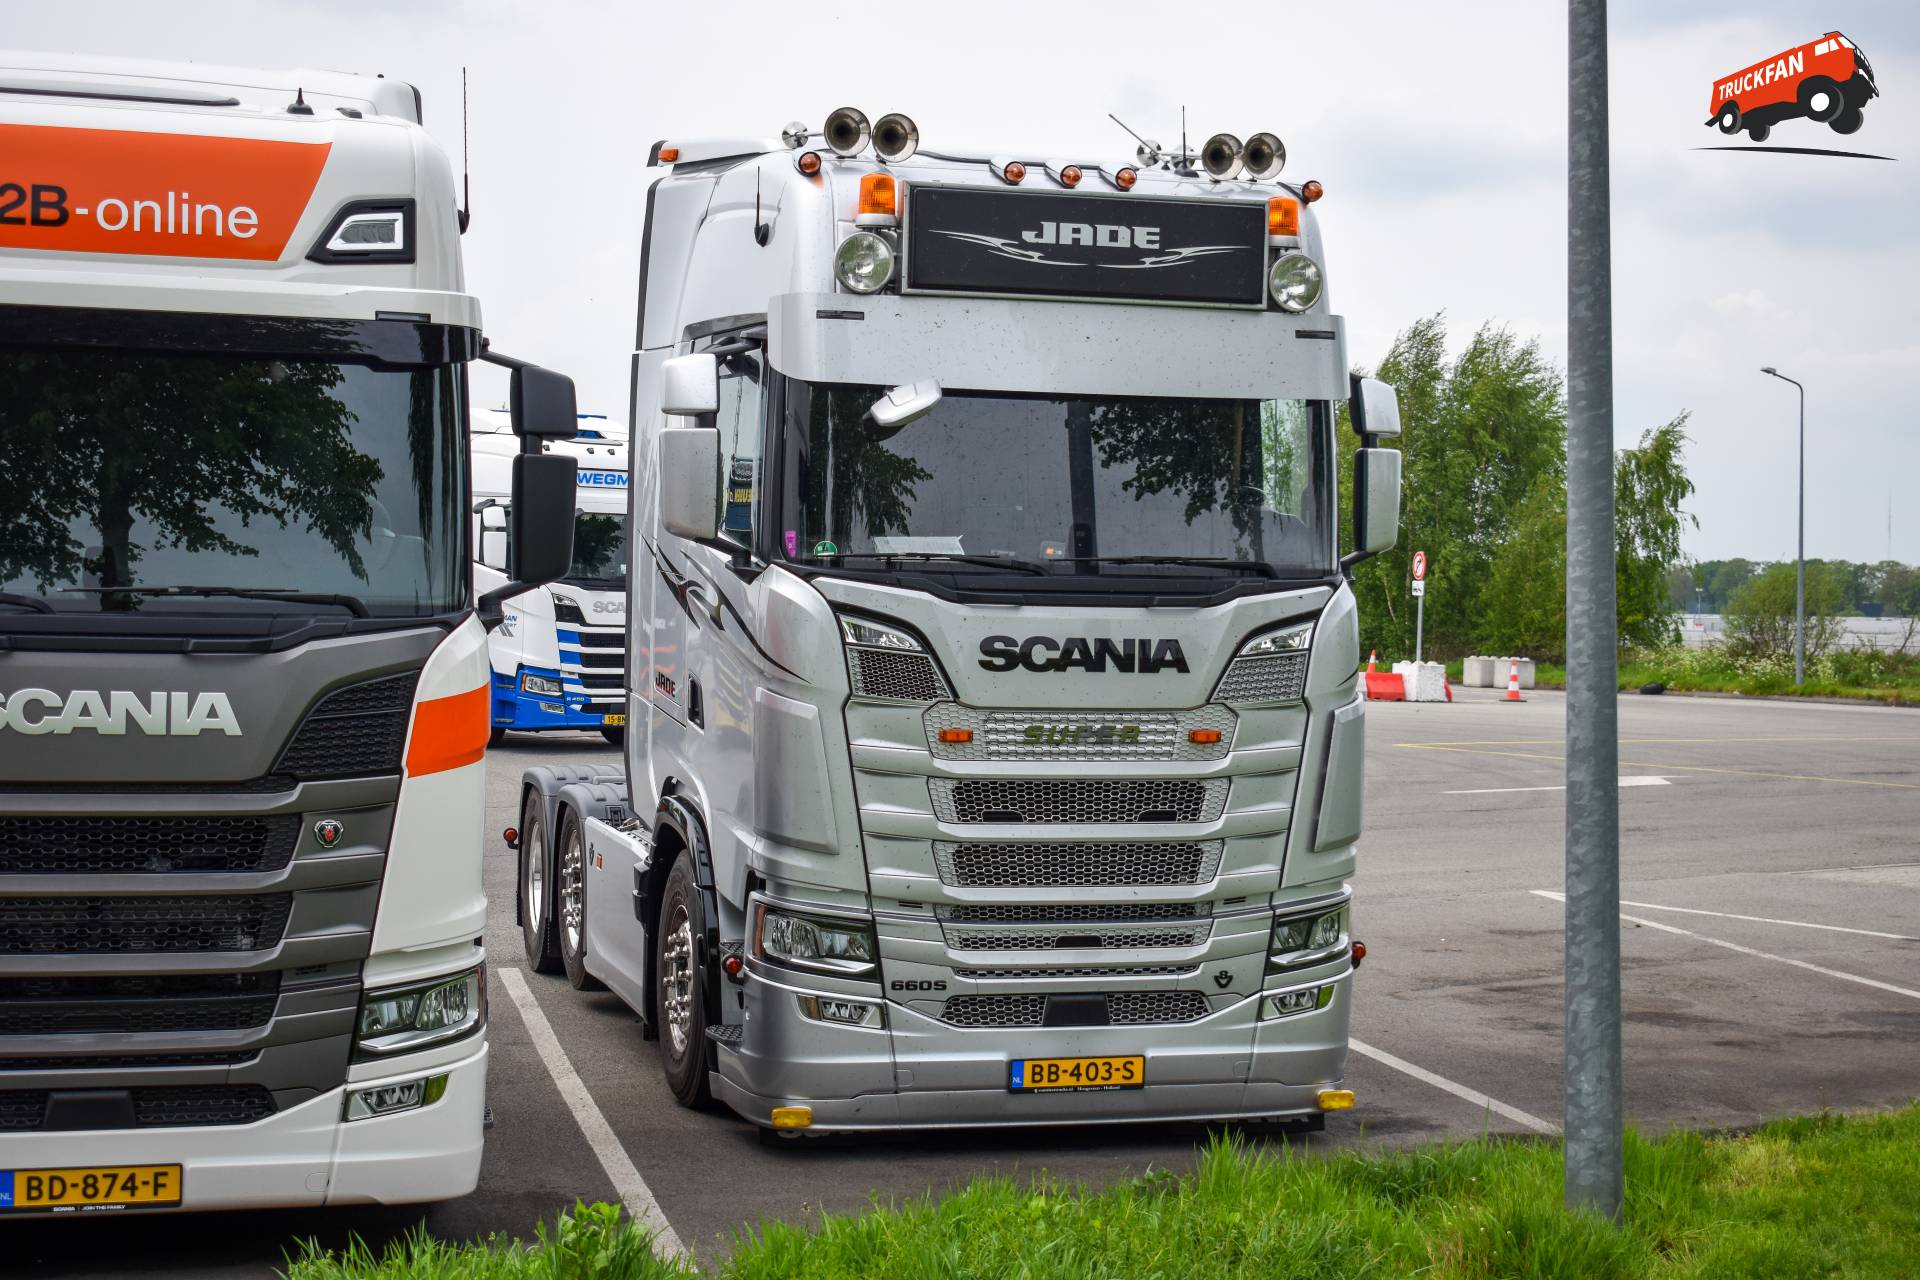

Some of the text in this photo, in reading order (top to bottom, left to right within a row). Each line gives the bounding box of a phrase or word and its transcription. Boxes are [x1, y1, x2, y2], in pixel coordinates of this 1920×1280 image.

[1021, 221, 1161, 250] JADE
[978, 635, 1191, 674] SCANIA
[655, 671, 676, 698] JADE
[0, 688, 243, 736] CANIA
[1023, 725, 1141, 745] SUPER
[891, 980, 947, 991] 660S
[1031, 1060, 1135, 1084] BB-403-S
[26, 1171, 169, 1201] BD-874-F
